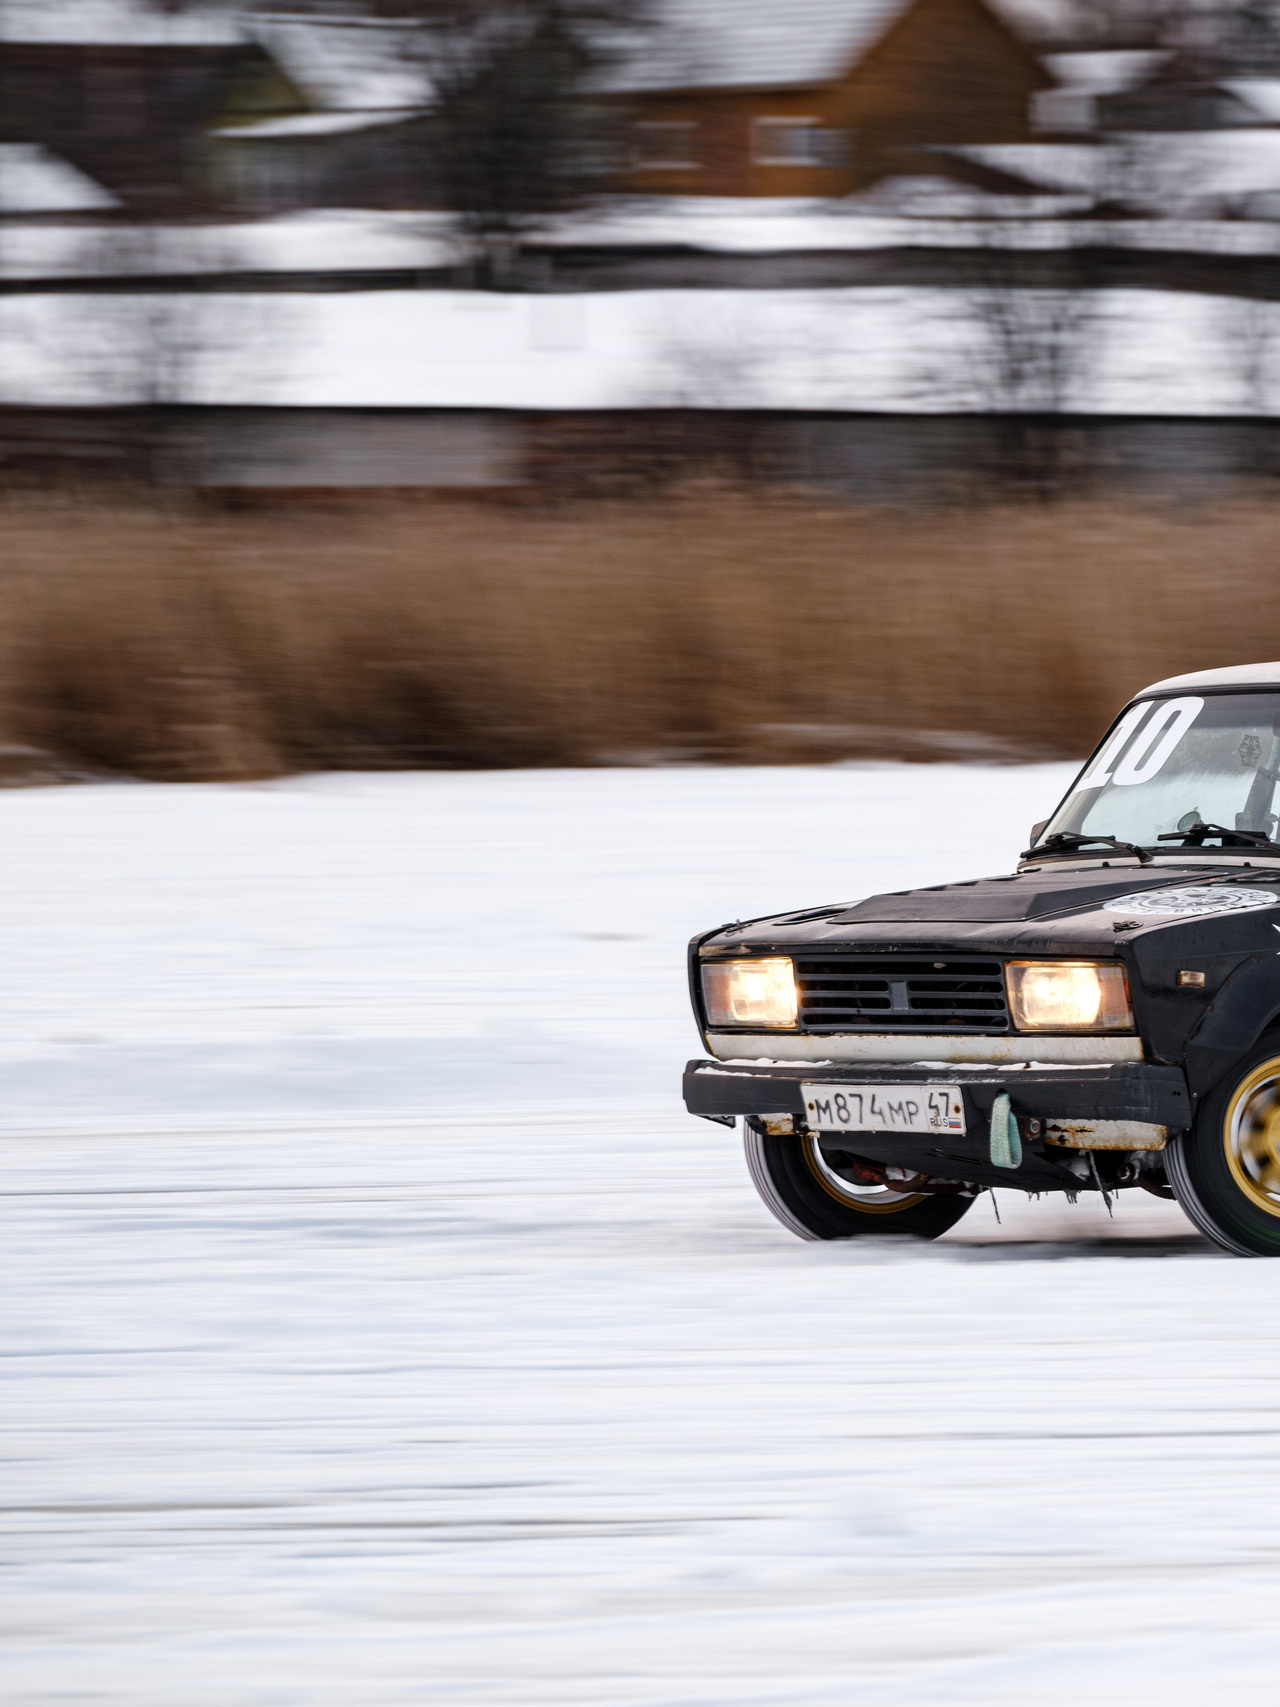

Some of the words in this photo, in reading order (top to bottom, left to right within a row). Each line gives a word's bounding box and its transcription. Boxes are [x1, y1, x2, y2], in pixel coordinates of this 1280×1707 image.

[1074, 697, 1204, 793] 10
[928, 1092, 950, 1117] 47
[930, 1117, 949, 1127] RUS
